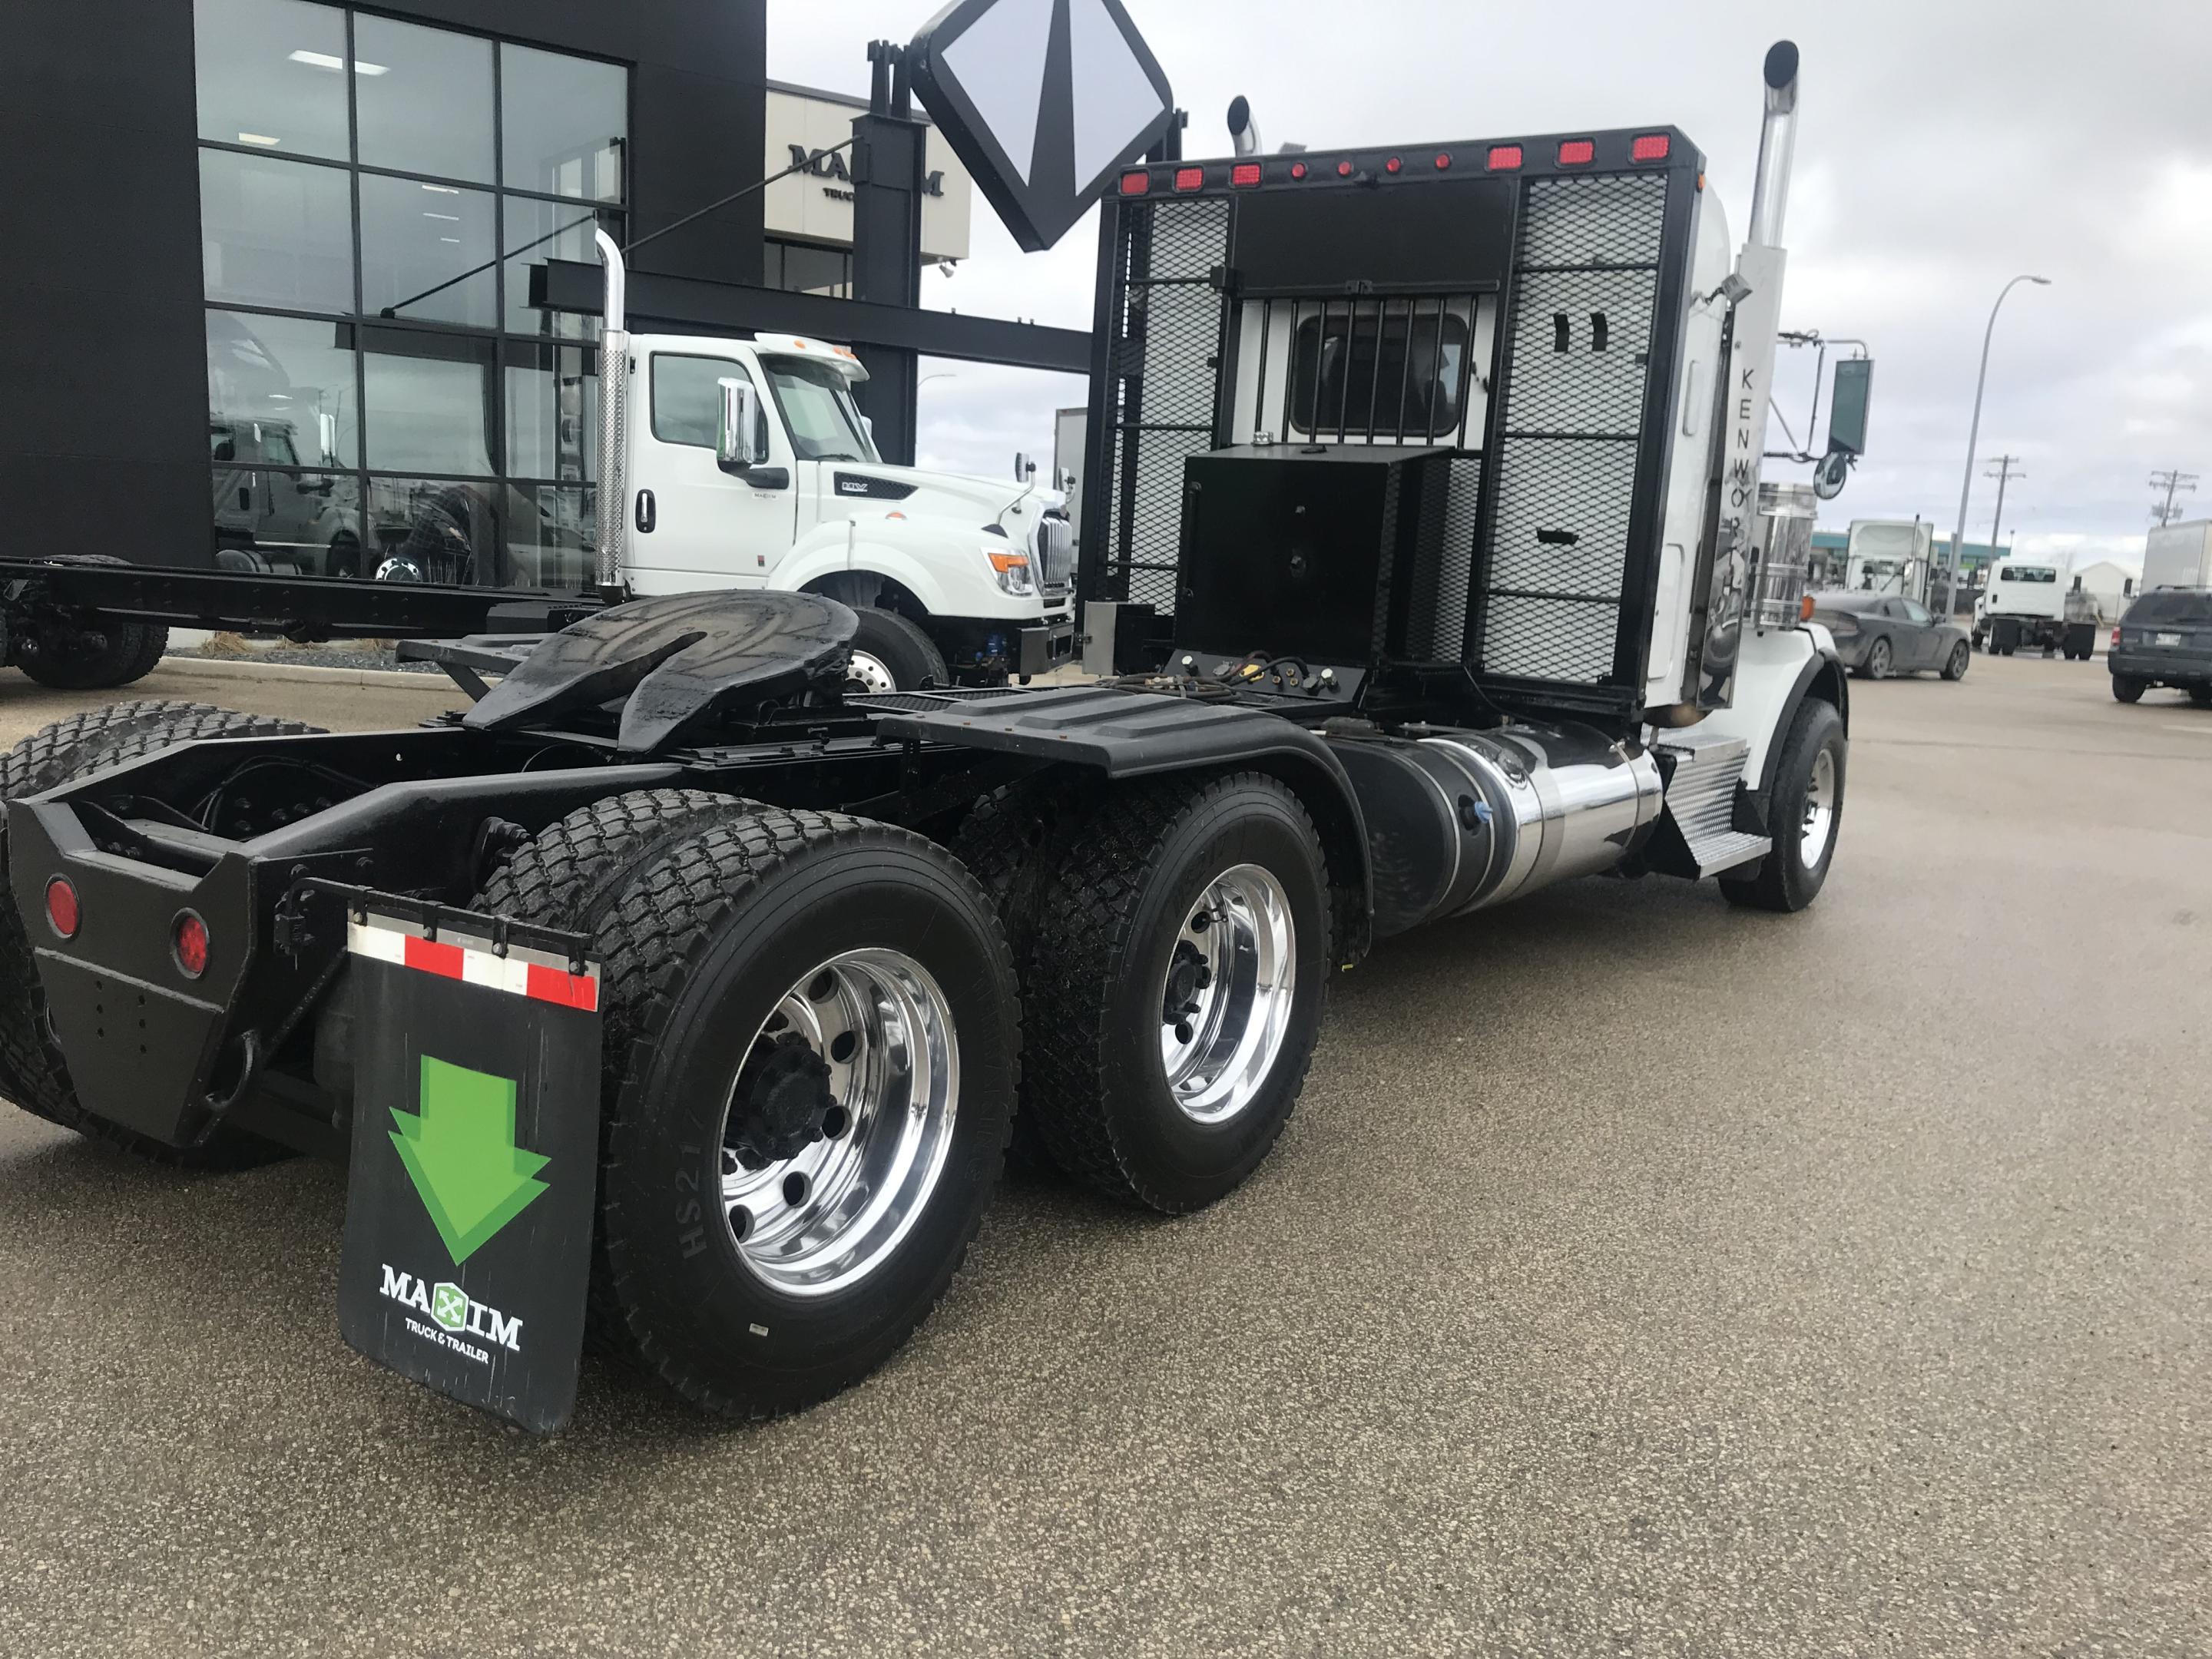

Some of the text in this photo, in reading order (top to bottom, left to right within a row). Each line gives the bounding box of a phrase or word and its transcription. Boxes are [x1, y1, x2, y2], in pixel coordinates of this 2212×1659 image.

[379, 1263, 523, 1351] MAXIM
[406, 1317, 488, 1364] TRUCK & TRAILER
